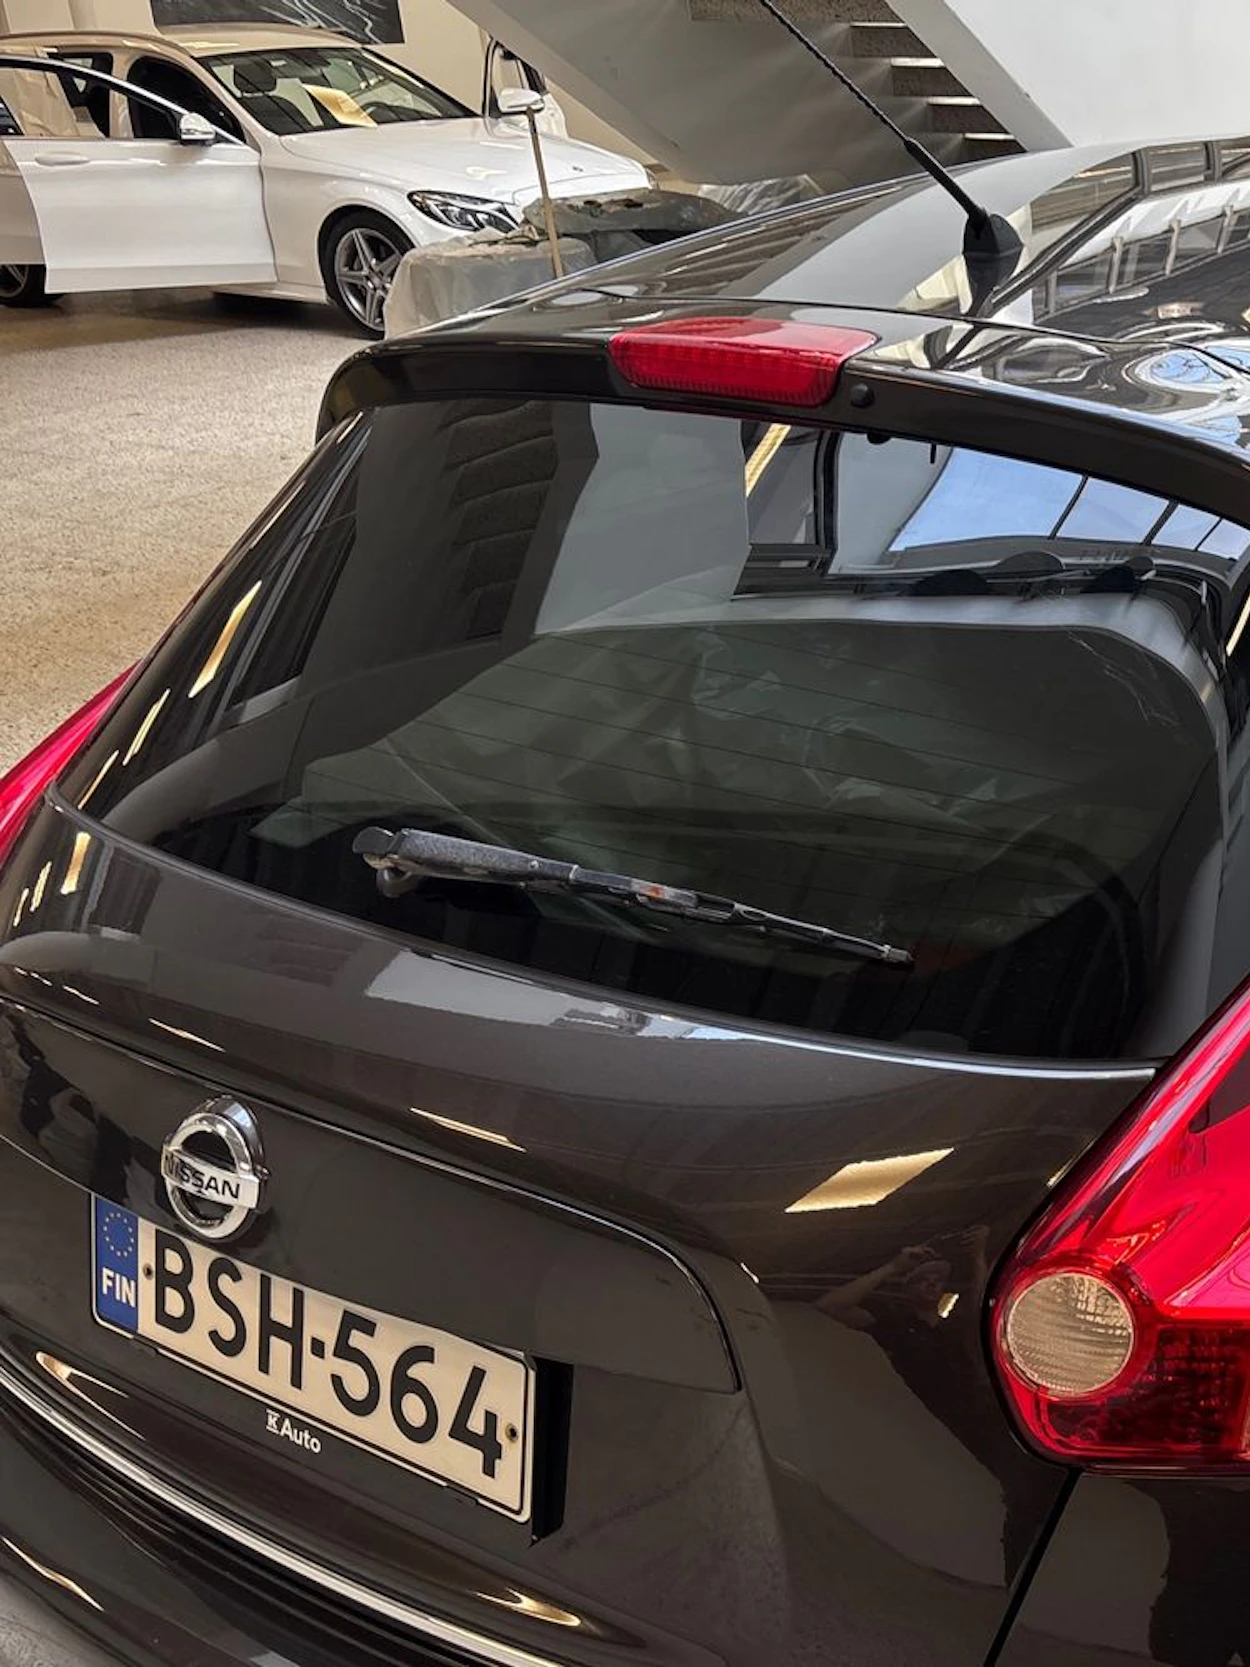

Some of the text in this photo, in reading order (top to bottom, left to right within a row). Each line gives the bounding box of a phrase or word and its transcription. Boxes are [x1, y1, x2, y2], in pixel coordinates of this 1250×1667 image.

[164, 1152, 241, 1200] NISSAN
[101, 1266, 137, 1309] FIN
[154, 1227, 503, 1481] BSH-564
